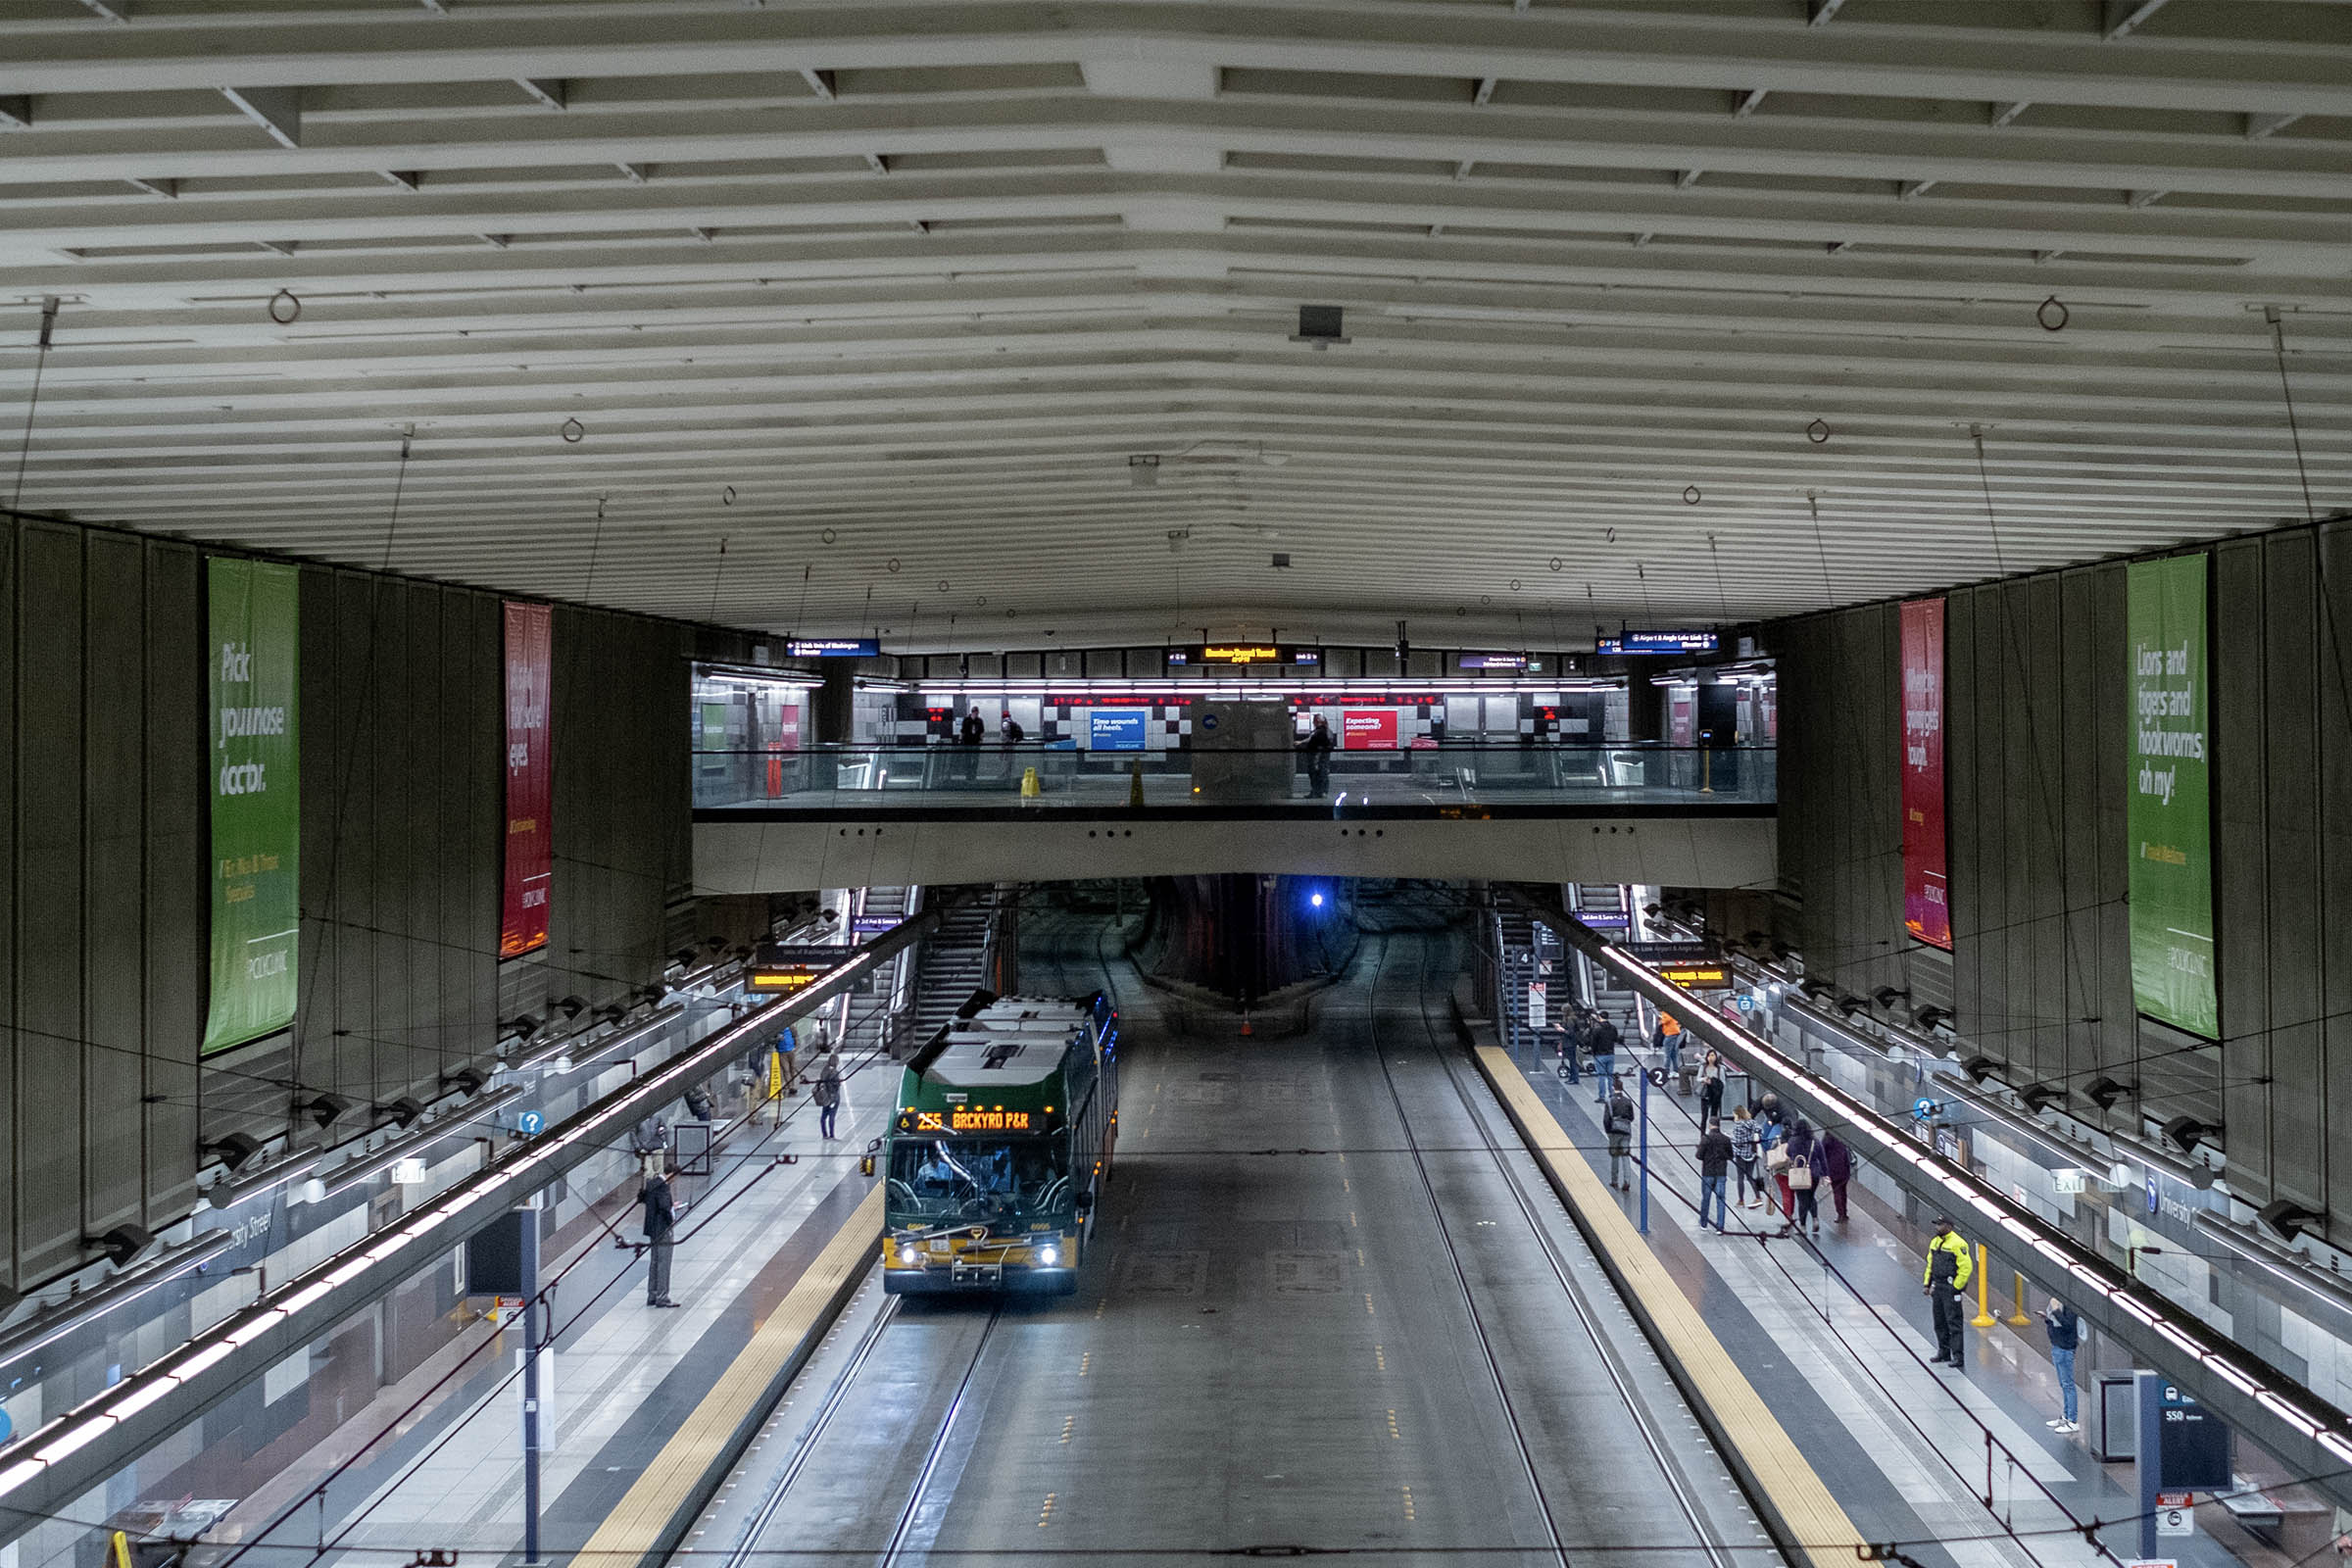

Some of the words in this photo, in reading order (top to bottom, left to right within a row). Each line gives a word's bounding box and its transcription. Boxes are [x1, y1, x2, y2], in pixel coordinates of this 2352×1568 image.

[221, 642, 251, 682] Pick
[2137, 643, 2162, 675] Lions
[2166, 640, 2187, 675] and
[2139, 682, 2168, 724] tigers
[2169, 680, 2191, 715] and
[253, 706, 283, 734] nose
[219, 755, 267, 796] doctor.
[510, 743, 528, 776] eyes
[2139, 760, 2152, 794] oh
[2154, 764, 2176, 805] my!
[1654, 1070, 1663, 1085] 2
[525, 1113, 539, 1132] ?
[917, 1112, 942, 1130] 255
[953, 1112, 1003, 1129] BRCKYRD
[1005, 1112, 1029, 1129] P&R
[249, 1209, 271, 1240] Street
[2159, 1191, 2191, 1231] University
[2166, 1410, 2184, 1421] 550
